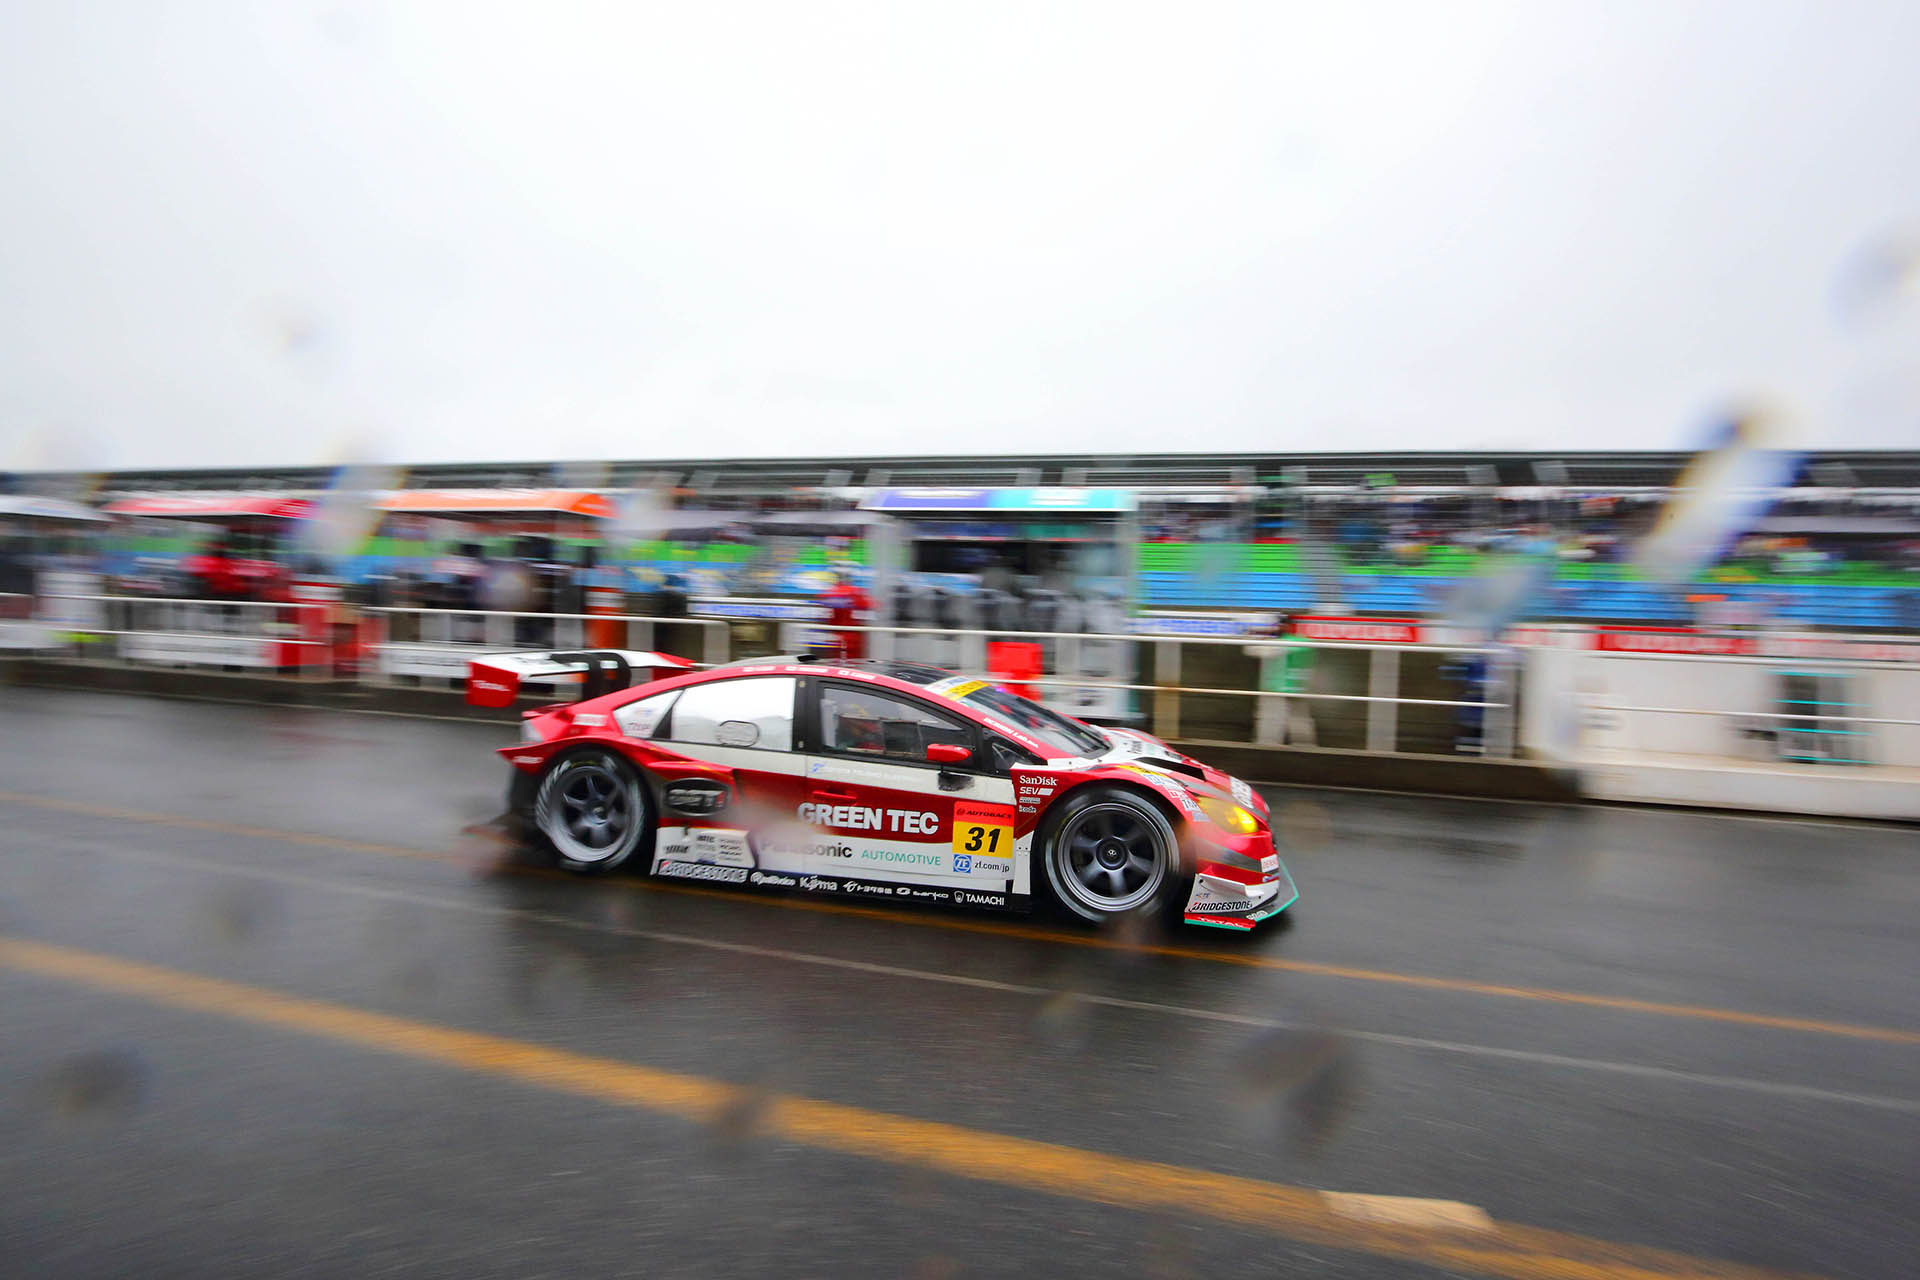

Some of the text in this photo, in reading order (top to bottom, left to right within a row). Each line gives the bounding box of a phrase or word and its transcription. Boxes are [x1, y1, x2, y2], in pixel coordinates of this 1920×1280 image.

[1019, 775, 1059, 786] SanDisk
[1019, 786, 1039, 796] SEV
[797, 802, 939, 836] GREEN TEC
[966, 809, 1012, 820] AUTOBACS
[965, 826, 1001, 853] 31
[761, 841, 853, 860] Psonic
[861, 850, 942, 866] AUTOMOTIVE
[965, 893, 1005, 906] TAMACHI
[1188, 900, 1252, 912] BRIDGESTONE
